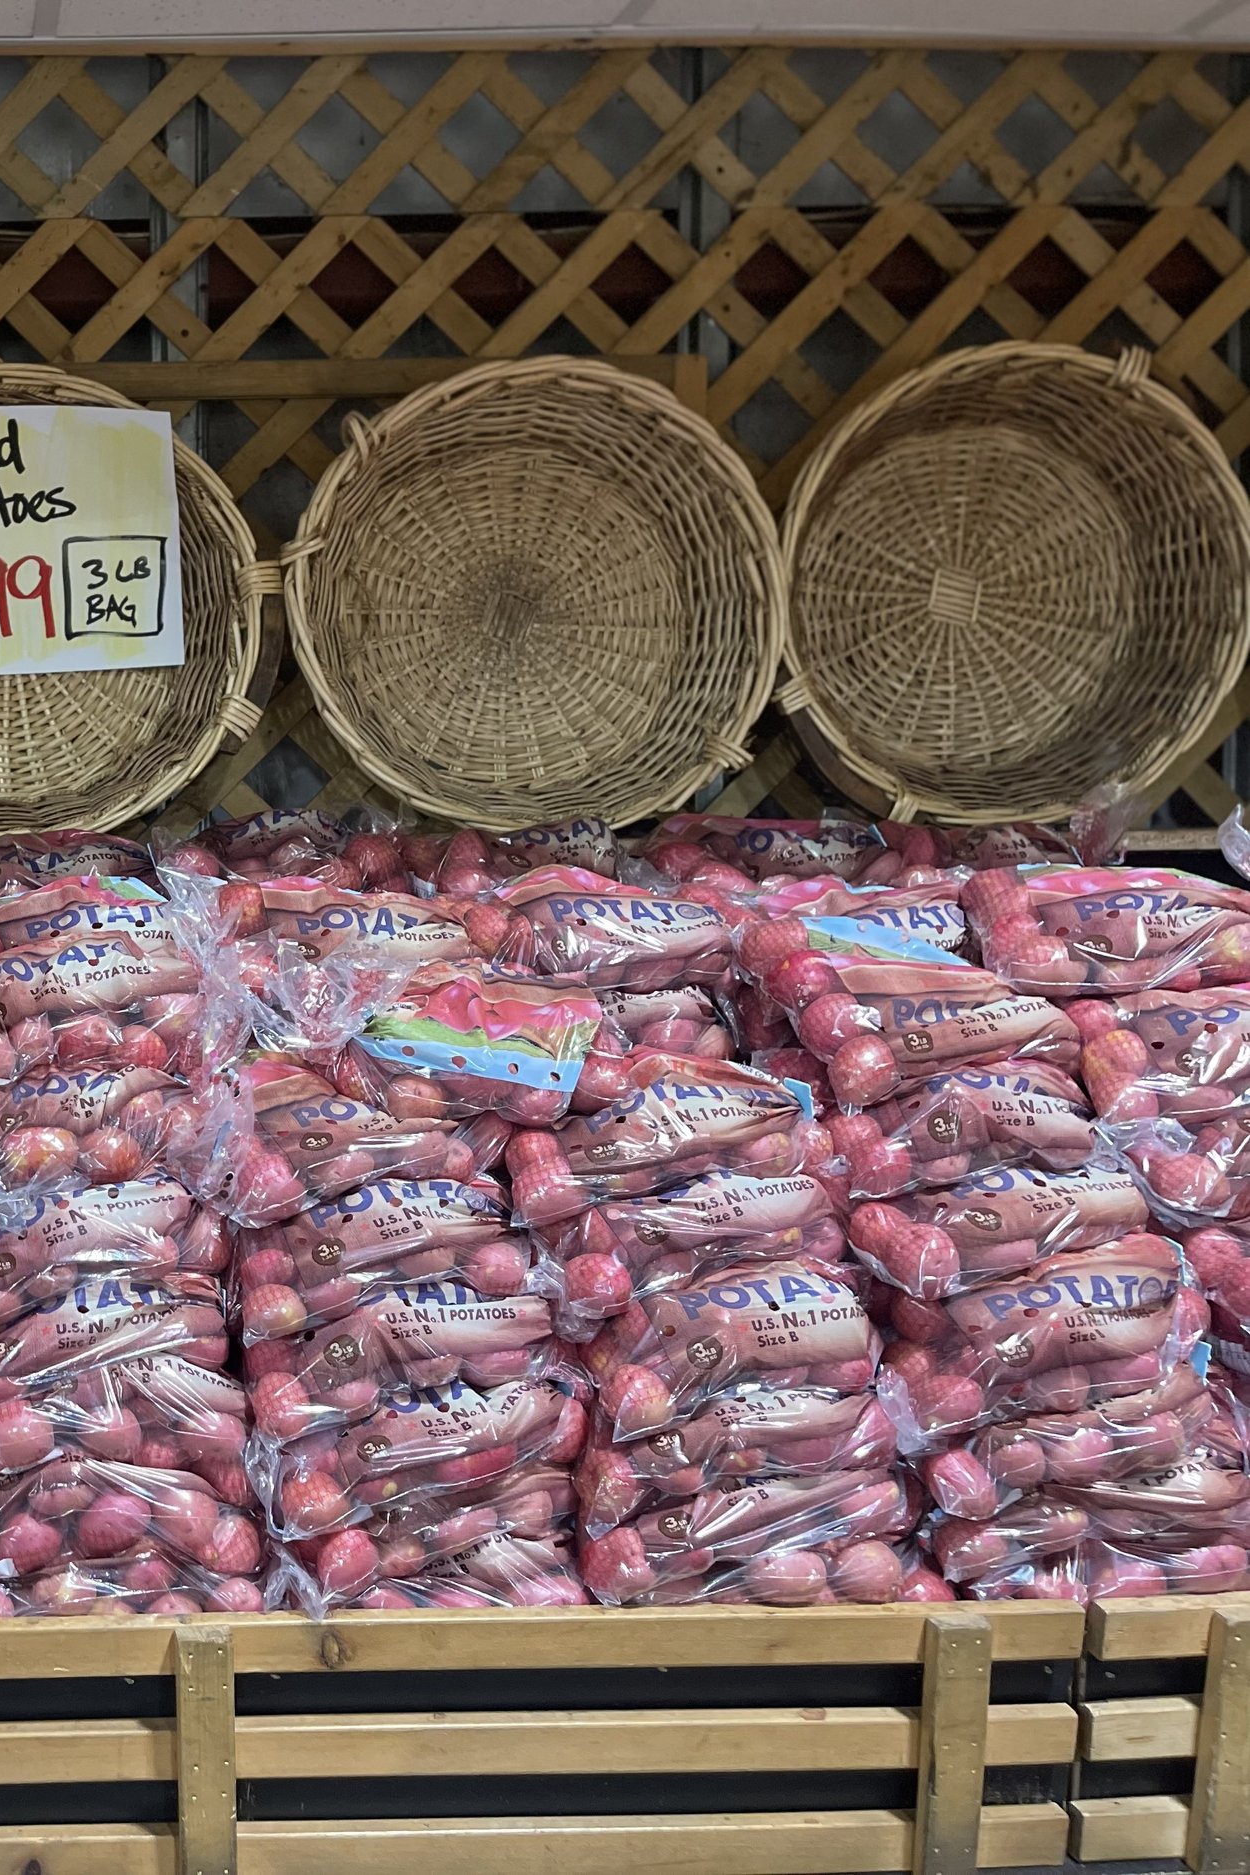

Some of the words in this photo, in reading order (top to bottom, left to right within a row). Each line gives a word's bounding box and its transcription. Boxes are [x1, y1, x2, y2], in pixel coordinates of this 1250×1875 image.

[82, 559, 108, 589] 3
[116, 556, 151, 582] LB
[86, 595, 136, 627] BAG
[397, 931, 456, 942] POTATOES
[1148, 929, 1168, 939] Size
[85, 964, 151, 983] POTATOES
[618, 1005, 626, 1014] B
[961, 1027, 987, 1039] Size
[990, 1023, 999, 1032] B
[992, 1102, 1018, 1113] U.S.
[1026, 1116, 1035, 1126] B
[759, 1180, 815, 1198] POTATOES
[1032, 1201, 1064, 1214] Size
[1067, 1197, 1076, 1206] B
[373, 1215, 403, 1229] U.S.
[700, 1212, 731, 1226] Size
[733, 1206, 744, 1218] B
[42, 1219, 67, 1235] U.S.
[380, 1225, 410, 1240] Size
[414, 1220, 424, 1230] B
[46, 1230, 75, 1247] Size
[77, 1225, 88, 1237] B
[386, 1311, 413, 1324] U.S.
[450, 1307, 516, 1321] POTATOES
[56, 1322, 85, 1334] U.S.
[751, 1316, 780, 1331] U.S.
[391, 1327, 420, 1340] Size
[423, 1324, 433, 1335] B
[757, 1334, 787, 1347] Size
[790, 1332, 800, 1343] B
[1069, 1330, 1096, 1345] Size
[421, 1417, 451, 1428] U.S.
[462, 1421, 472, 1431] B
[759, 1489, 770, 1501] B
